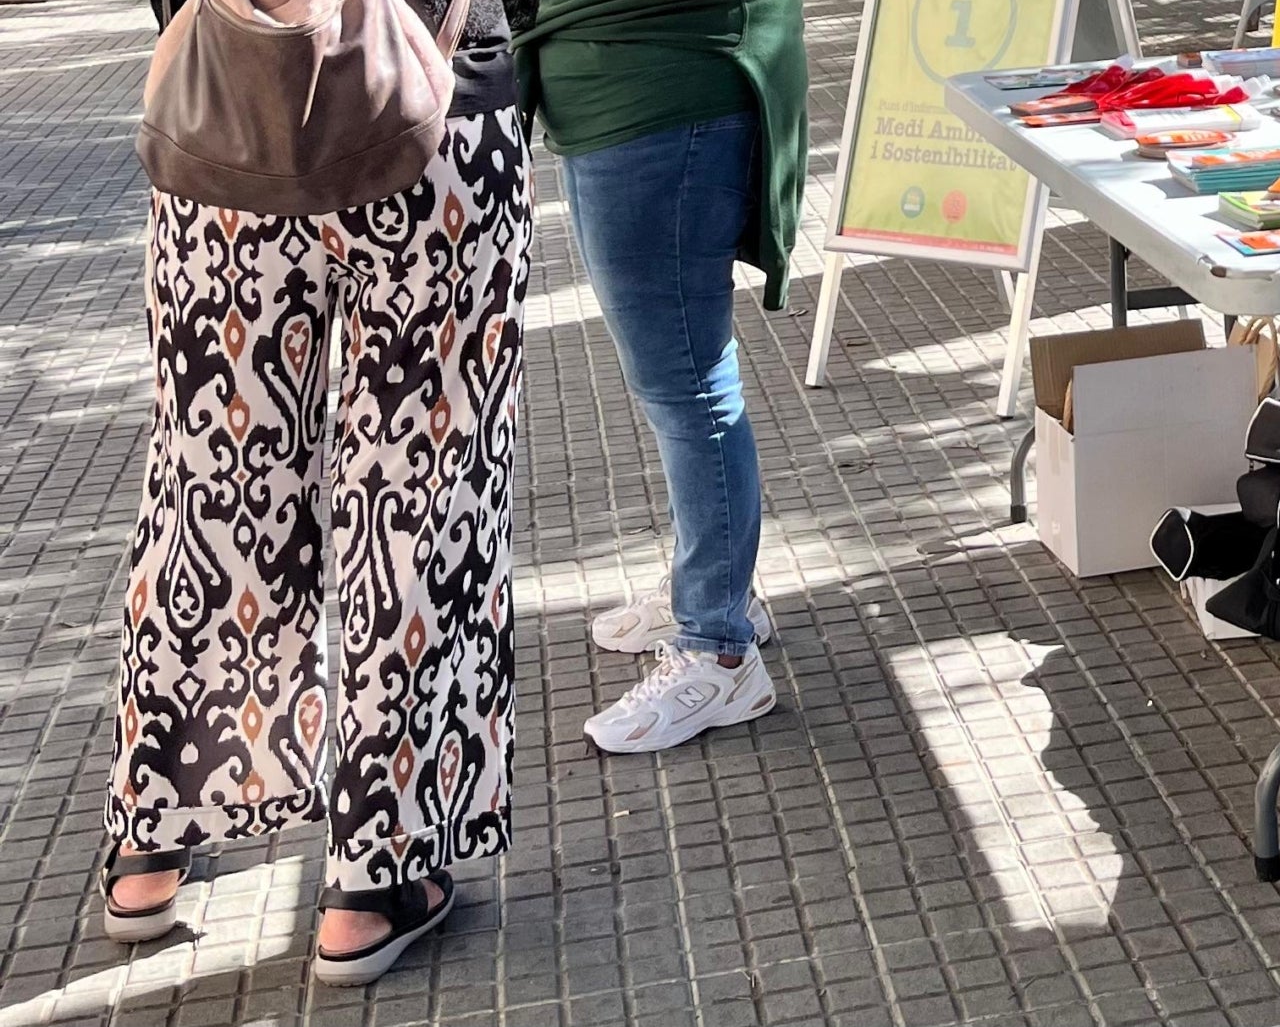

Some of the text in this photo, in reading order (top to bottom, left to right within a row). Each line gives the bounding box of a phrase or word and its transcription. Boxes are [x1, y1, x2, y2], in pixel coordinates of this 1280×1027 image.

[874, 116, 924, 138] Medi
[870, 140, 878, 160] i
[675, 686, 705, 708] N
